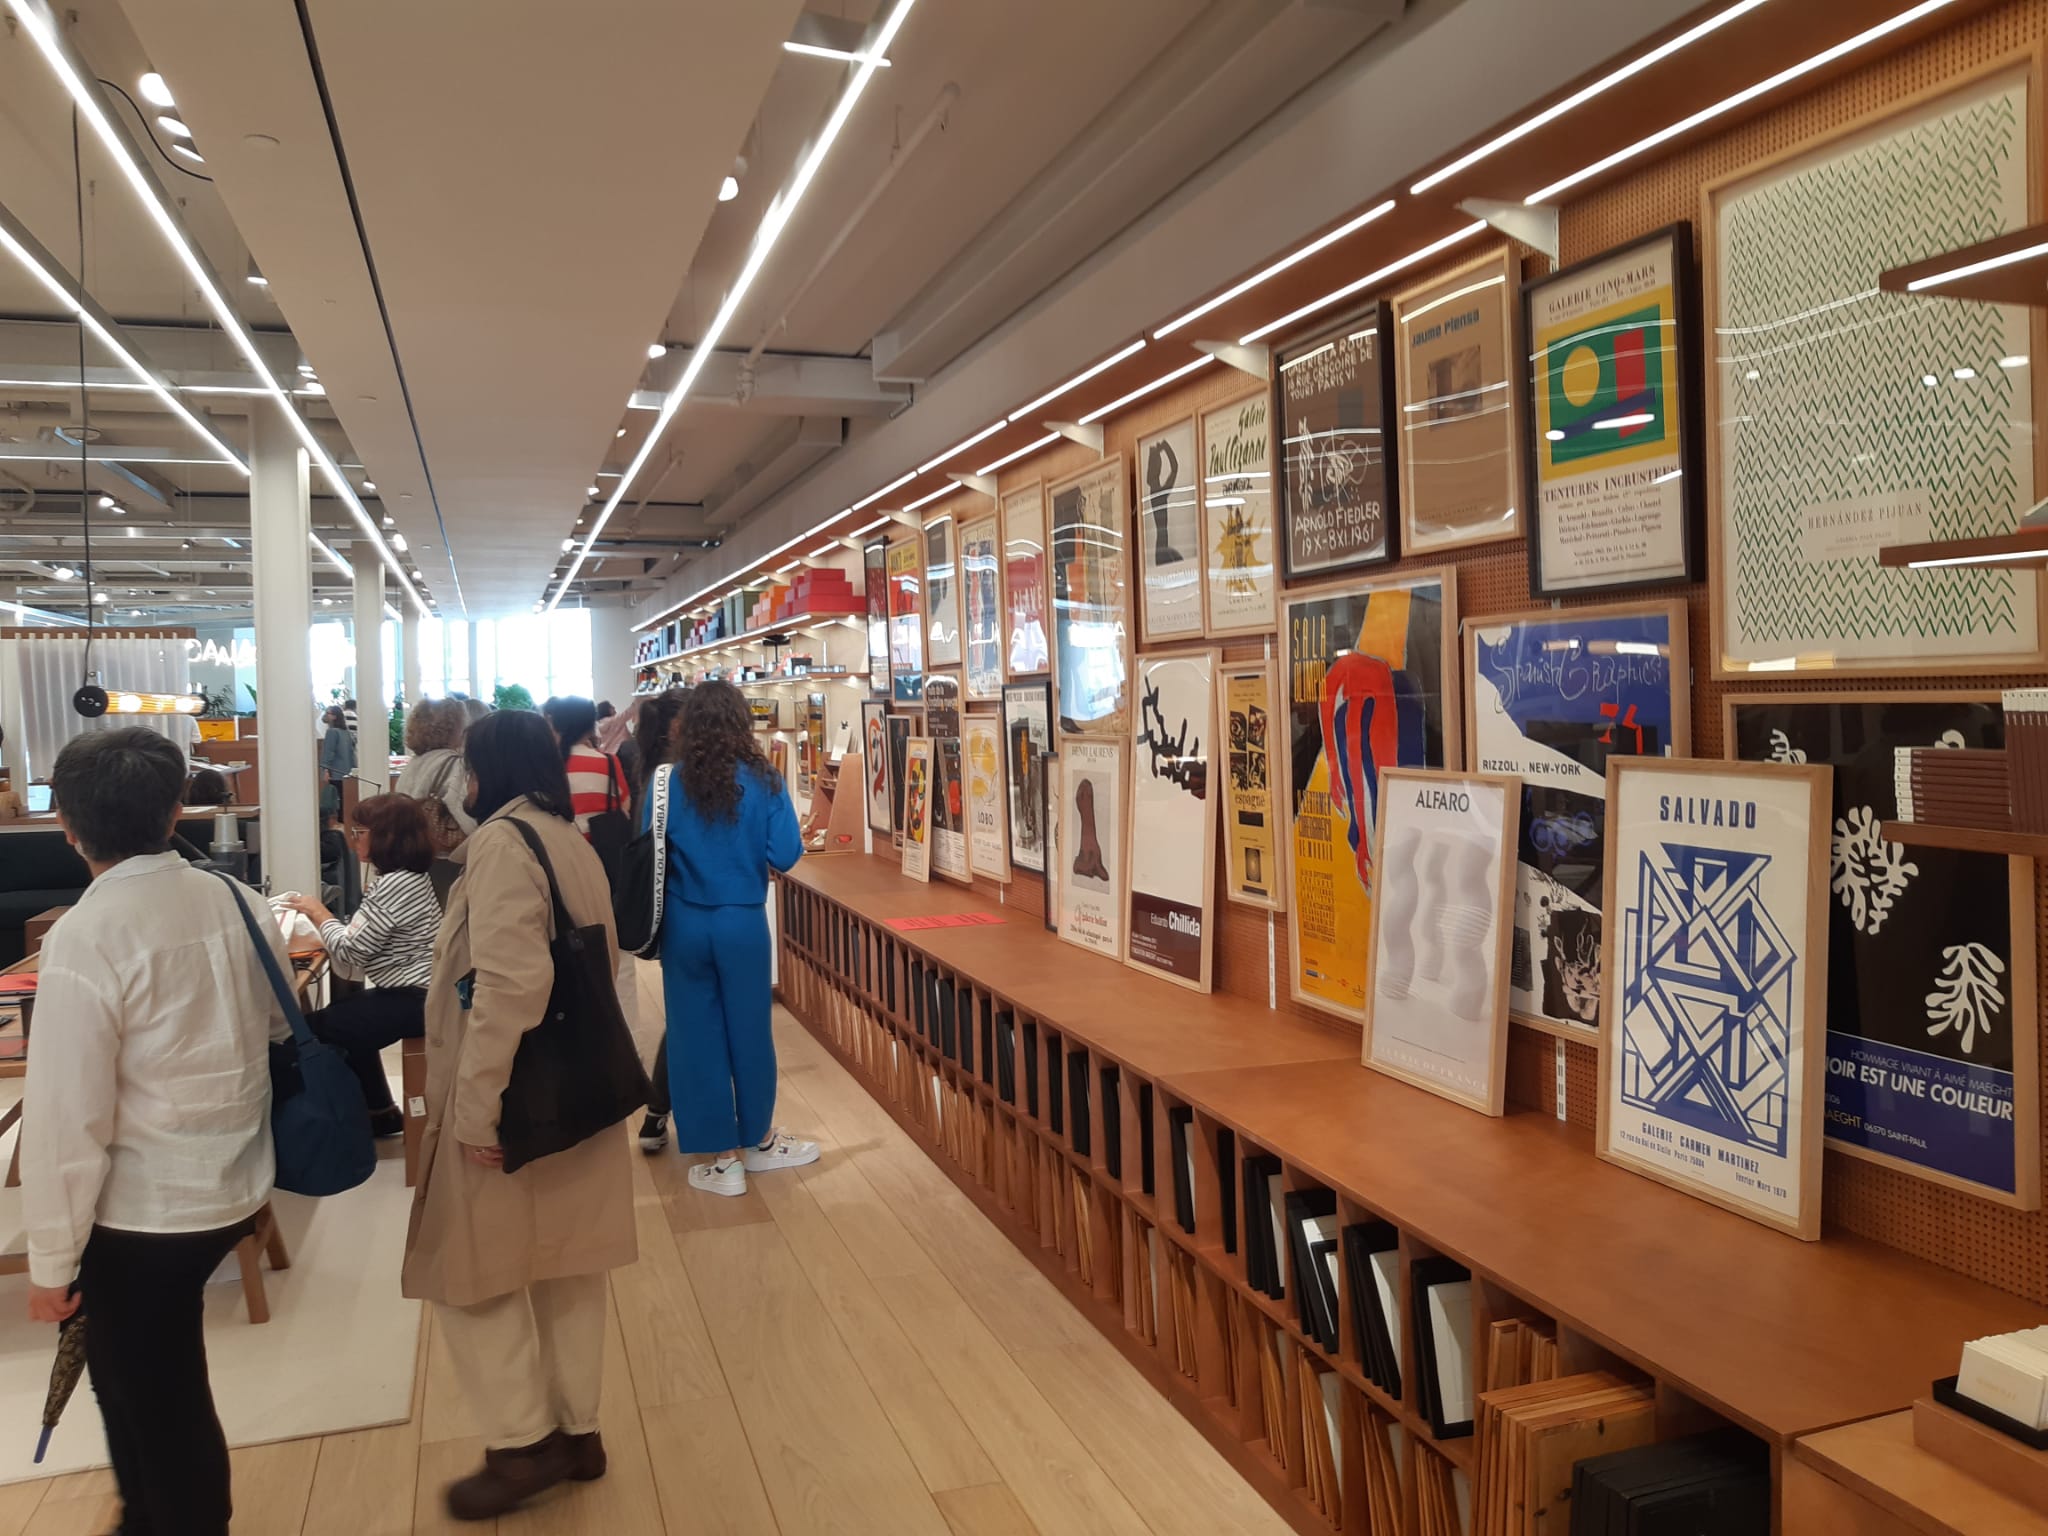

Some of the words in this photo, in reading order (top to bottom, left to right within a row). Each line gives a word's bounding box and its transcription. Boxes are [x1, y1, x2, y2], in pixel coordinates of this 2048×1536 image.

[1549, 288, 1592, 313] GALERIE
[1360, 346, 1373, 363] DE
[1318, 372, 1344, 394] PARIS
[1544, 481, 1599, 503] TENTURES
[1294, 510, 1335, 537] ARNOLD
[1336, 500, 1380, 529] FIEDLER
[1302, 537, 1312, 557] 19
[1293, 614, 1327, 660] SALA
[1293, 658, 1328, 704] OLIMPIA
[1482, 759, 1519, 773] RIZZOLI
[1529, 762, 1581, 776] NEW-YORK
[1415, 789, 1471, 813] ALFARO
[1659, 795, 1757, 829] SALVADO
[1168, 910, 1200, 937] Chillida
[1850, 1049, 1899, 1071] HOMMAGE
[1901, 1061, 1932, 1078] VIVANT
[1968, 1079, 2013, 1098] MAEGHT
[1860, 1065, 1888, 1088] EST
[1891, 1073, 1926, 1099] UNE
[1930, 1084, 2013, 1121] COULEUR
[1642, 1122, 1673, 1143] GALERIE
[1680, 1135, 1711, 1157] CARMEN
[1718, 1149, 1760, 1175] MARTINEZ
[1674, 1149, 1688, 1162] Paris
[1757, 1179, 1771, 1193] Mars
